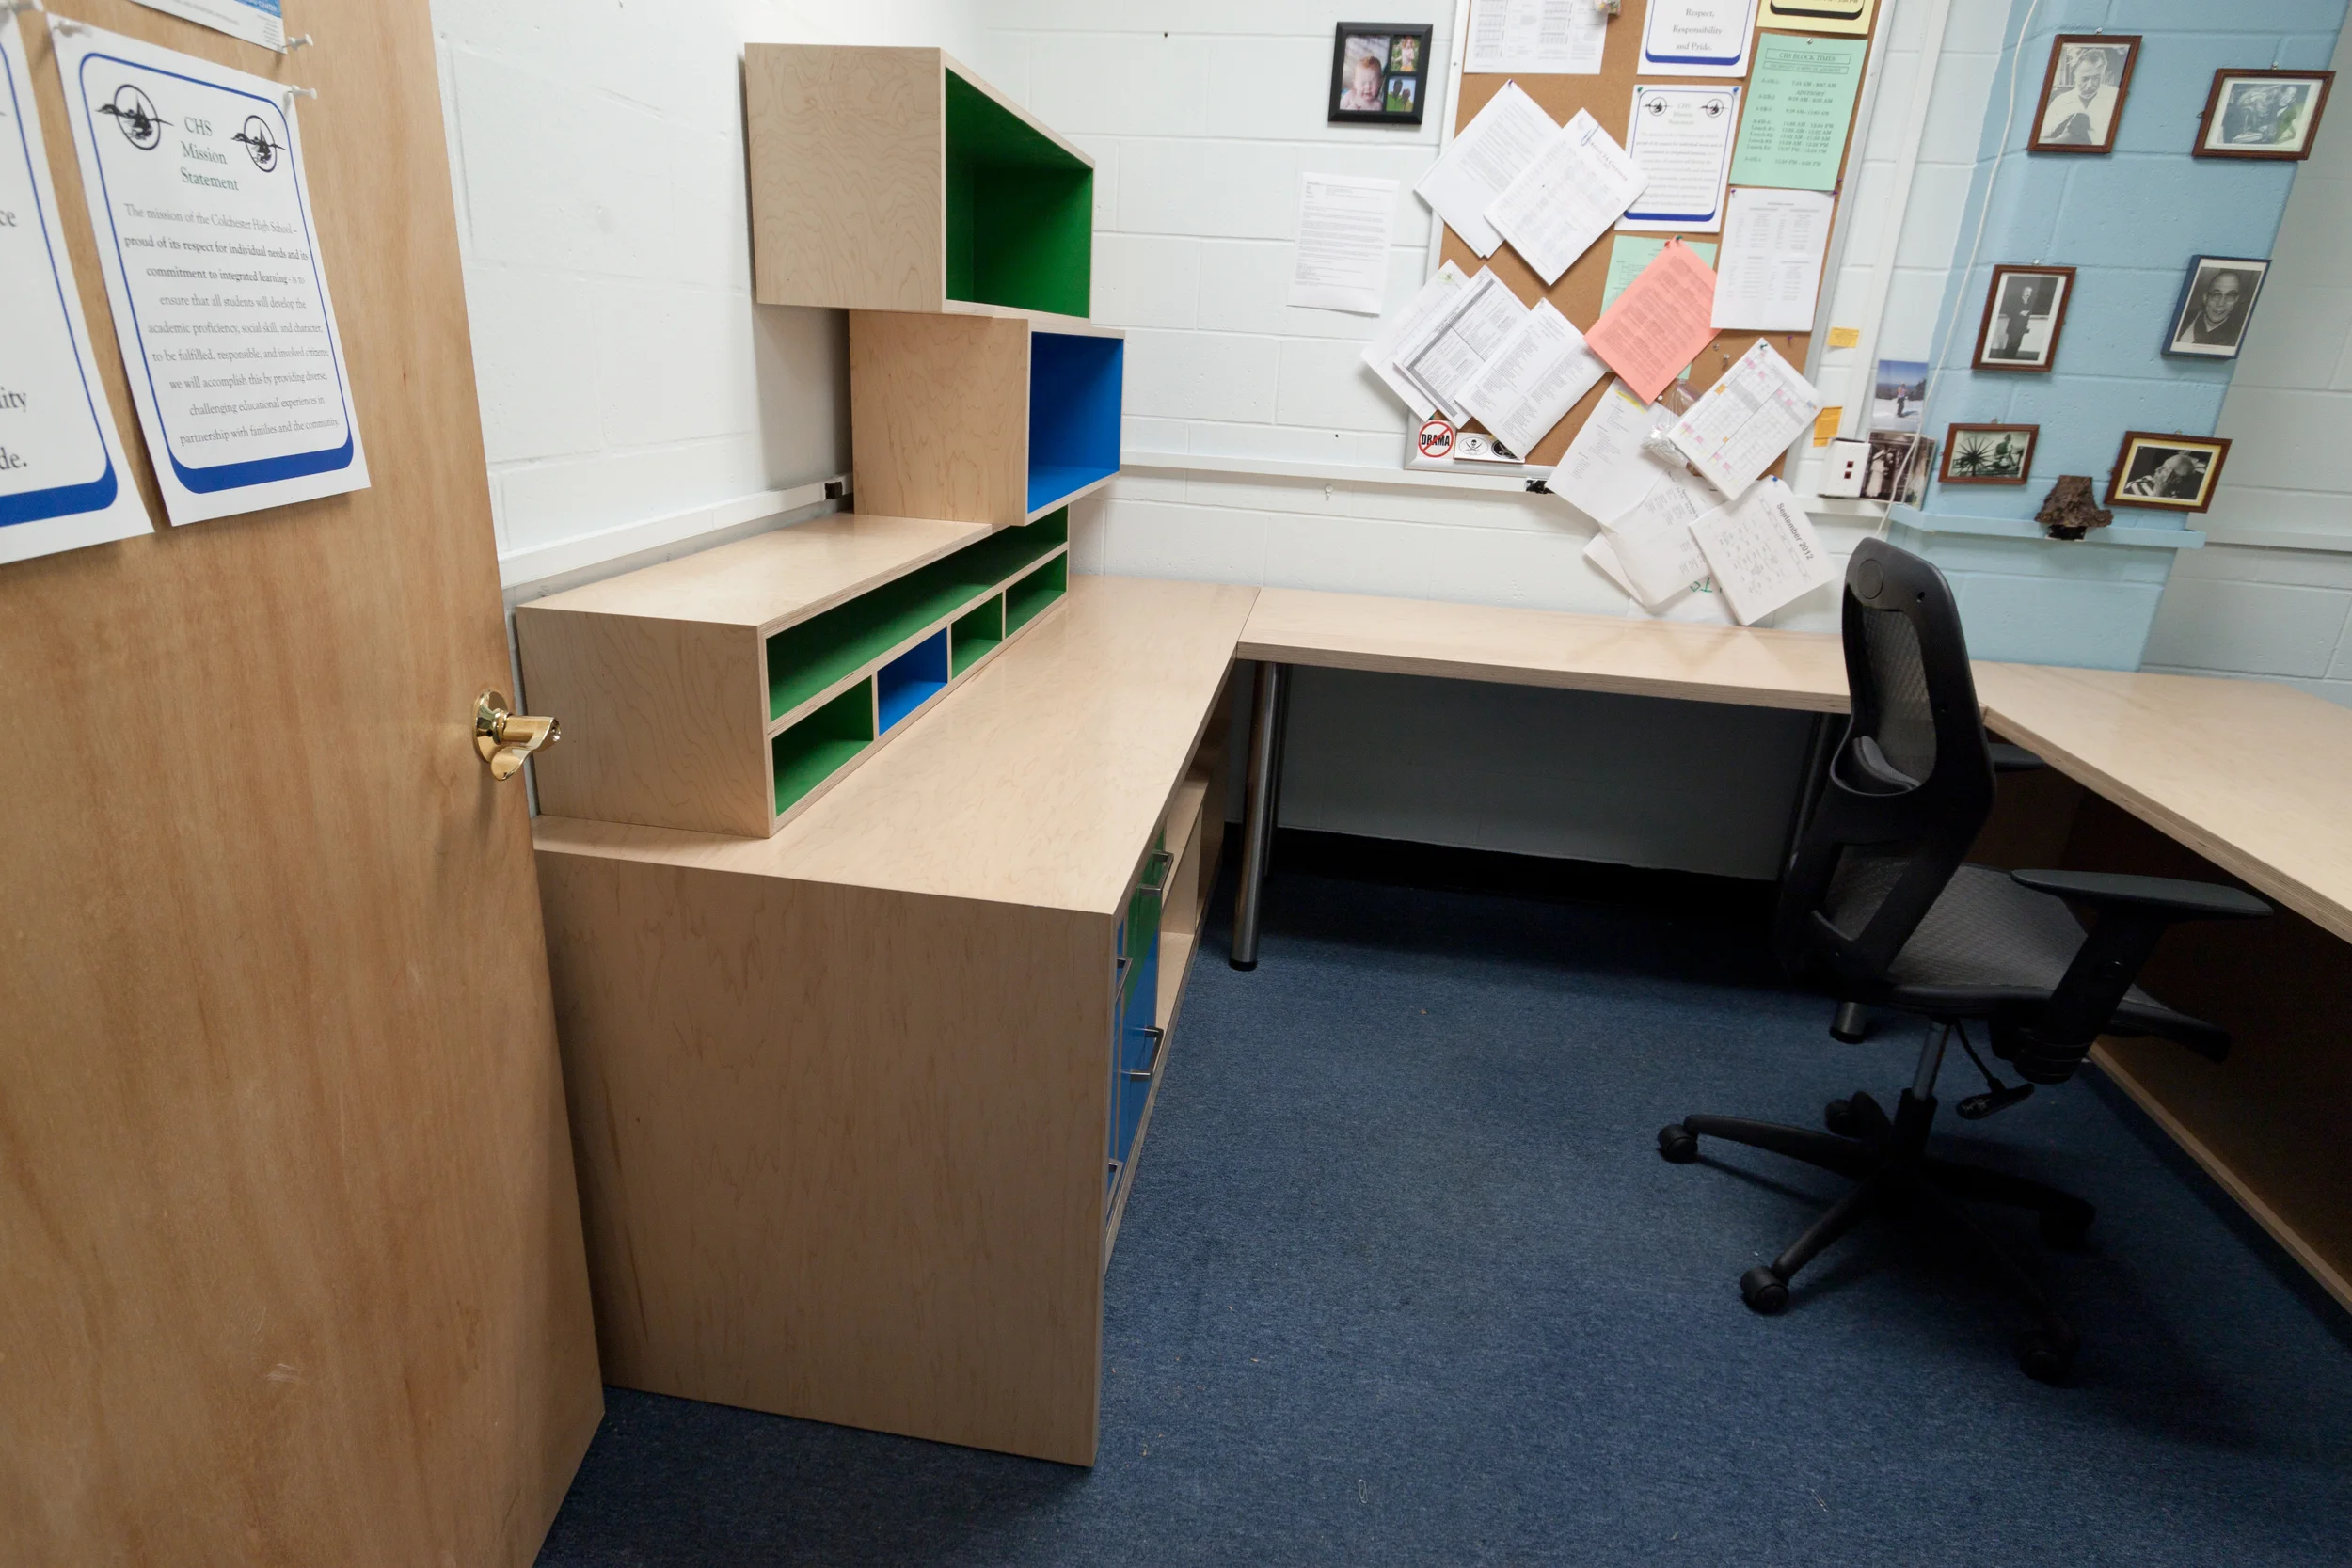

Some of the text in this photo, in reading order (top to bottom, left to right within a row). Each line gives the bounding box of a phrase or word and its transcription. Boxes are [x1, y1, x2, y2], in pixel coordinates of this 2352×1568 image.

[1673, 24, 1723, 36] Responsibility
[184, 116, 213, 137] CHS
[181, 141, 228, 165] Mission
[181, 167, 239, 191] Statement
[124, 203, 144, 218] The
[147, 208, 183, 222] mission
[184, 211, 195, 223] of
[196, 212, 211, 225] the
[211, 213, 251, 230] Colchester
[252, 218, 270, 233] High
[270, 220, 294, 234] School
[124, 235, 309, 261] proud of its respect for individual needs and its
[147, 265, 207, 279] commitment
[209, 270, 218, 280] to
[218, 268, 258, 282] integrated
[258, 271, 288, 286] learning
[159, 293, 307, 310] ensure that all students will develop the
[148, 320, 190, 334] academic
[192, 321, 240, 336] proficiency,
[242, 322, 262, 333] social
[281, 322, 294, 333] and
[152, 354, 163, 362] to
[164, 349, 177, 361] be
[178, 348, 216, 361] fulfilled,
[216, 348, 262, 362] responsible,
[263, 346, 278, 358] and
[278, 346, 305, 357] involved
[169, 380, 183, 389] we
[184, 375, 201, 388] will
[203, 374, 247, 388] accomplish
[248, 372, 263, 385] this
[262, 372, 272, 386] by
[273, 371, 305, 386] providing
[189, 396, 326, 416] challenging educational experiences in
[179, 429, 230, 448] partnership
[231, 425, 249, 438] with
[250, 423, 278, 436] families
[278, 421, 292, 433] and
[294, 420, 305, 431] the
[1422, 435, 1450, 446] DRAMA
[1776, 502, 1815, 562] September 2012
